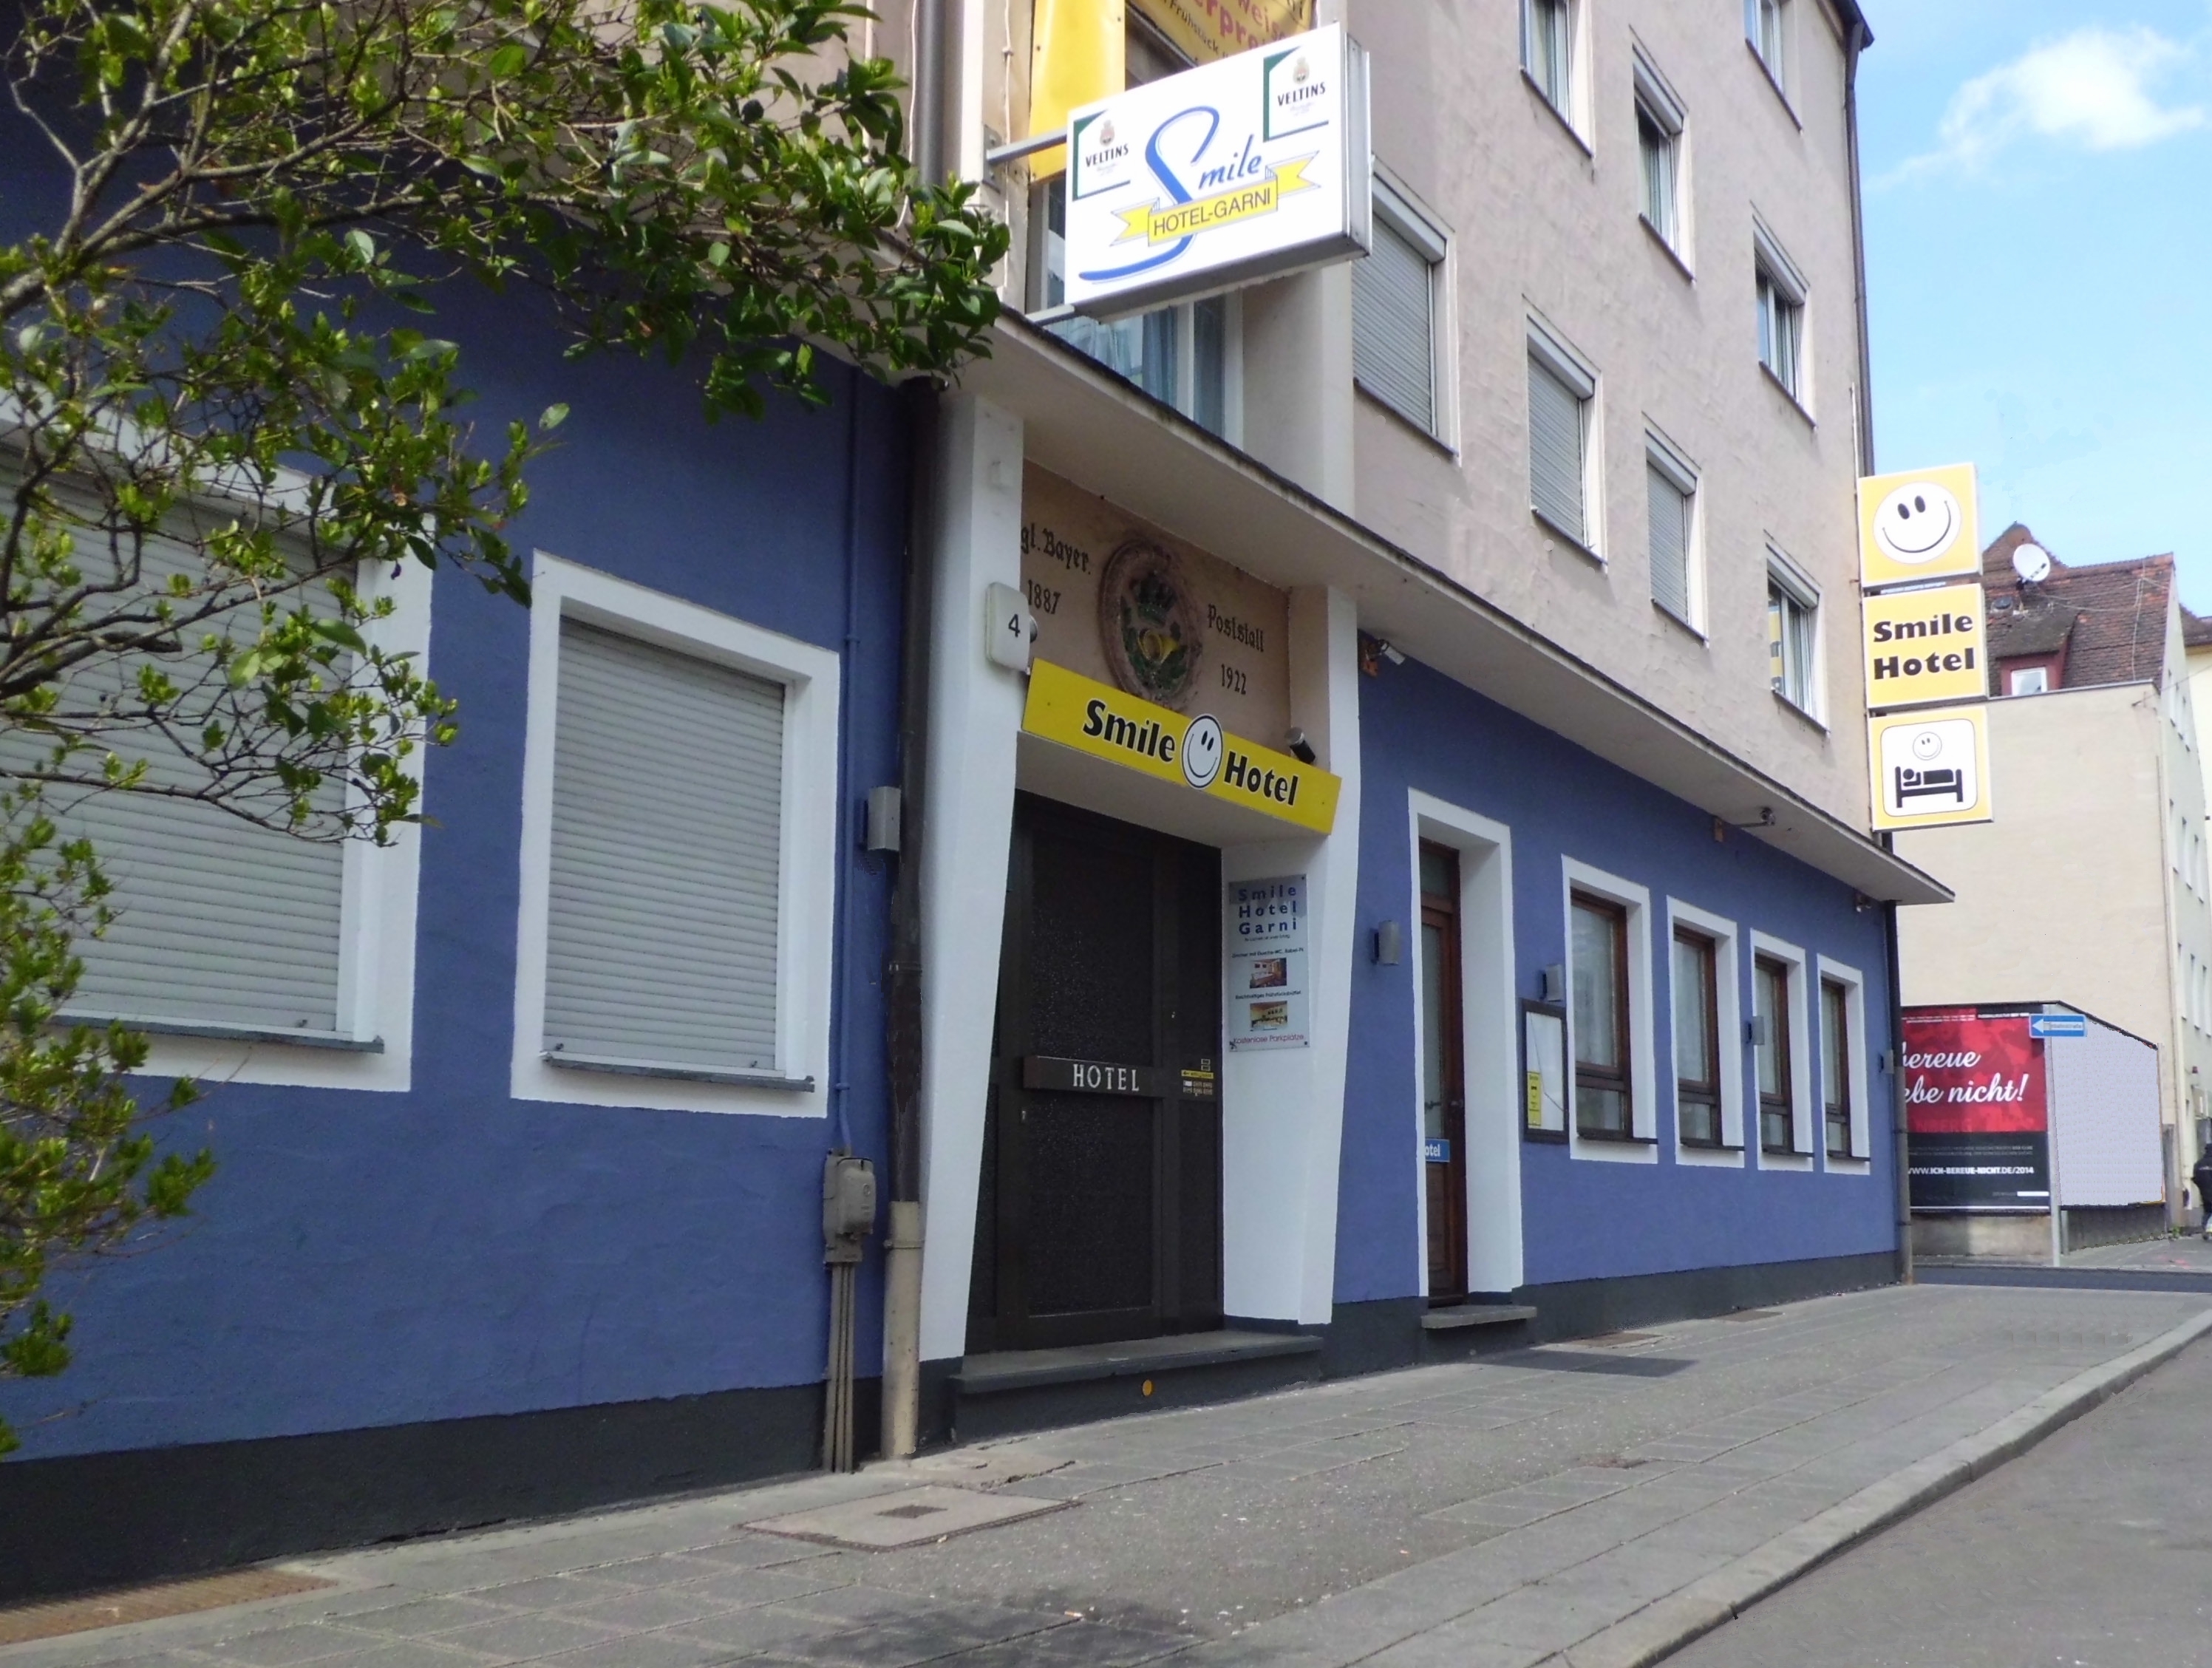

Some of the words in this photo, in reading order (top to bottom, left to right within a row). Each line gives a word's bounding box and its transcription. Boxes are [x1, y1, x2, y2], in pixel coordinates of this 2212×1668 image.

[1277, 81, 1326, 106] VELTINS
[1086, 143, 1129, 168] VELTINS
[1153, 188, 1271, 236] HOTEL-GARNI
[1027, 579, 1061, 614] 1887
[1007, 613, 1021, 637] 4
[1873, 613, 1974, 644] Smile
[1874, 647, 1976, 681] Hotel
[1220, 663, 1247, 695] 1922
[1082, 699, 1176, 763] Smile
[1224, 750, 1299, 807] Hotel
[1238, 885, 1297, 902] Smile
[1239, 900, 1297, 919] Hotel
[1239, 918, 1297, 936] Garni
[1072, 1063, 1140, 1092] HOTEL
[1948, 1072, 2029, 1103] nicht!
[1425, 1144, 1440, 1157] otel
